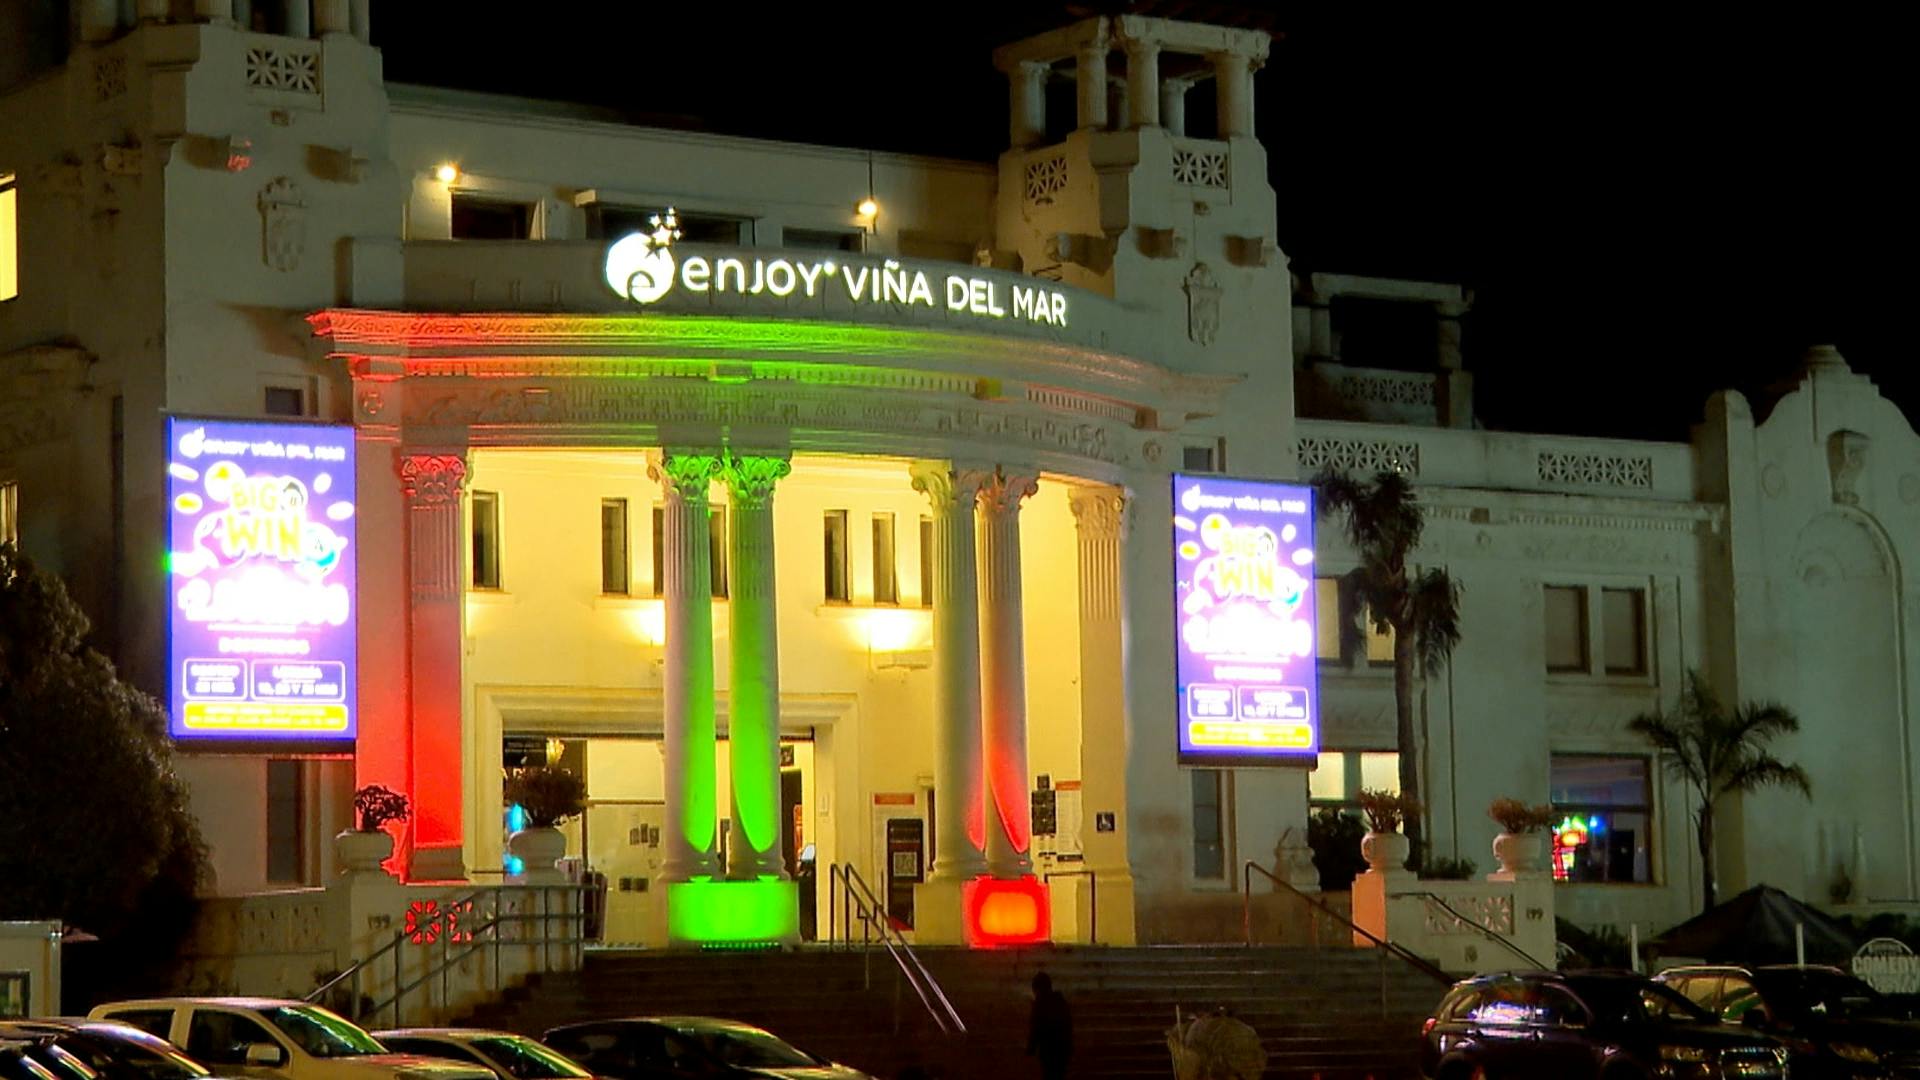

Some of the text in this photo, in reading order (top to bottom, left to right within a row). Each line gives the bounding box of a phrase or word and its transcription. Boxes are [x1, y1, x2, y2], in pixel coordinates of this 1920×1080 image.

[842, 259, 934, 306] VIÑA
[946, 275, 1005, 317] DEL
[1012, 285, 1067, 327] MAR
[231, 482, 277, 513] BIG
[227, 513, 300, 556] WIN
[1218, 559, 1273, 596] WIN
